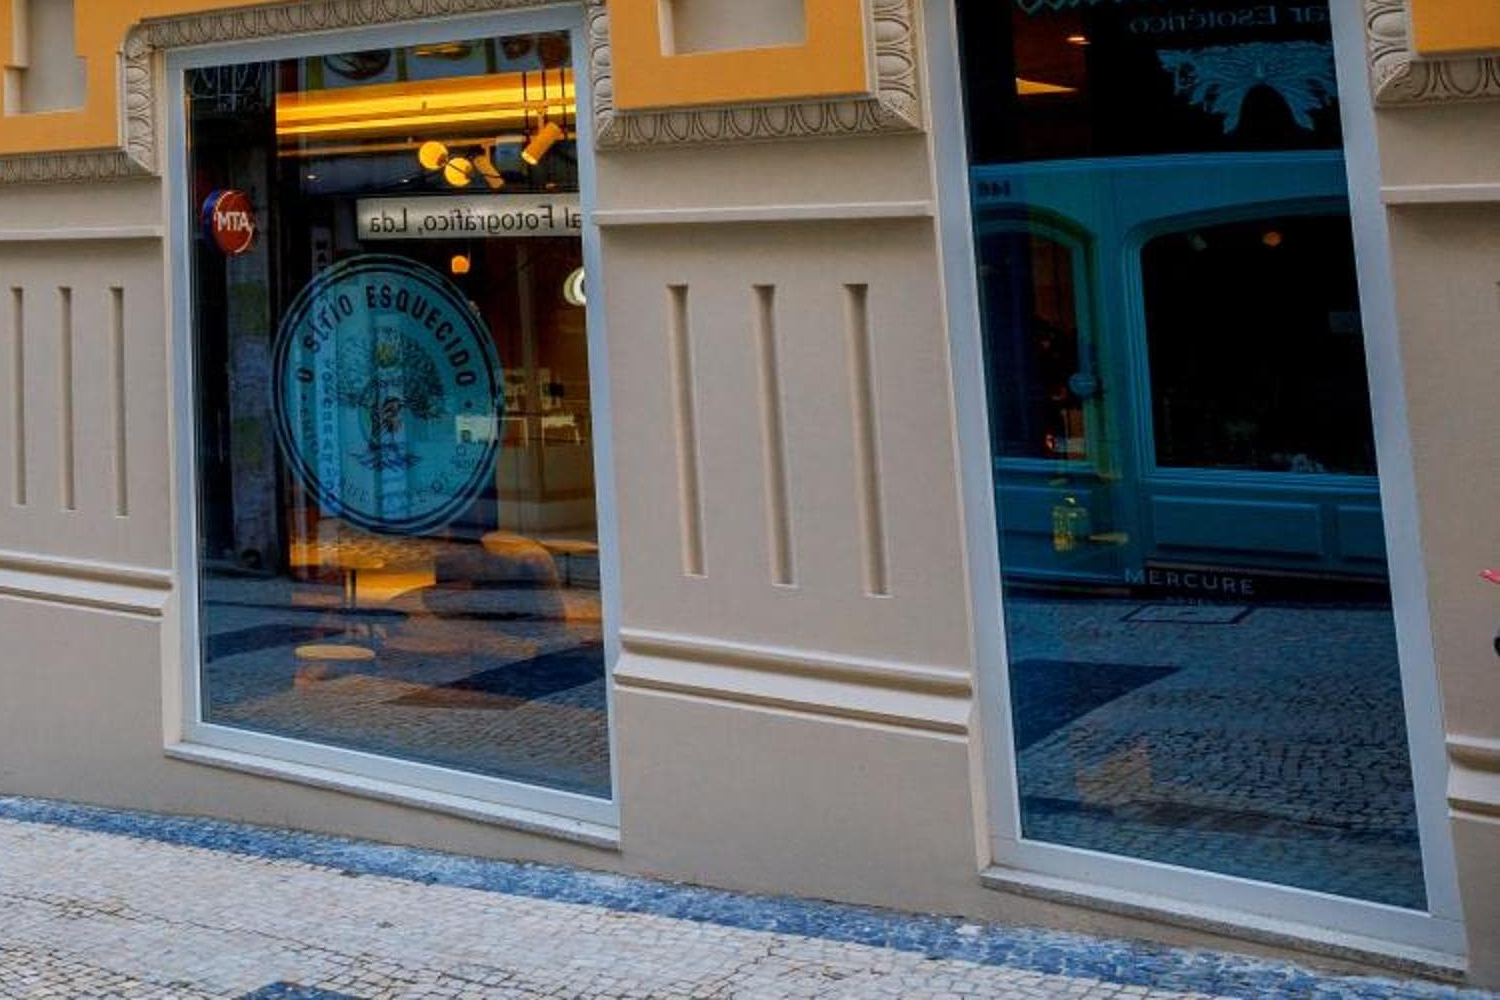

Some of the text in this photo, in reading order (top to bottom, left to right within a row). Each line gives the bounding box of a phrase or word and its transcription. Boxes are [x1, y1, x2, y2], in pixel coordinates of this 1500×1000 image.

[297, 366, 315, 384] O
[366, 285, 475, 387] ESQUECIDO
[1124, 567, 1255, 596] MERCURE
